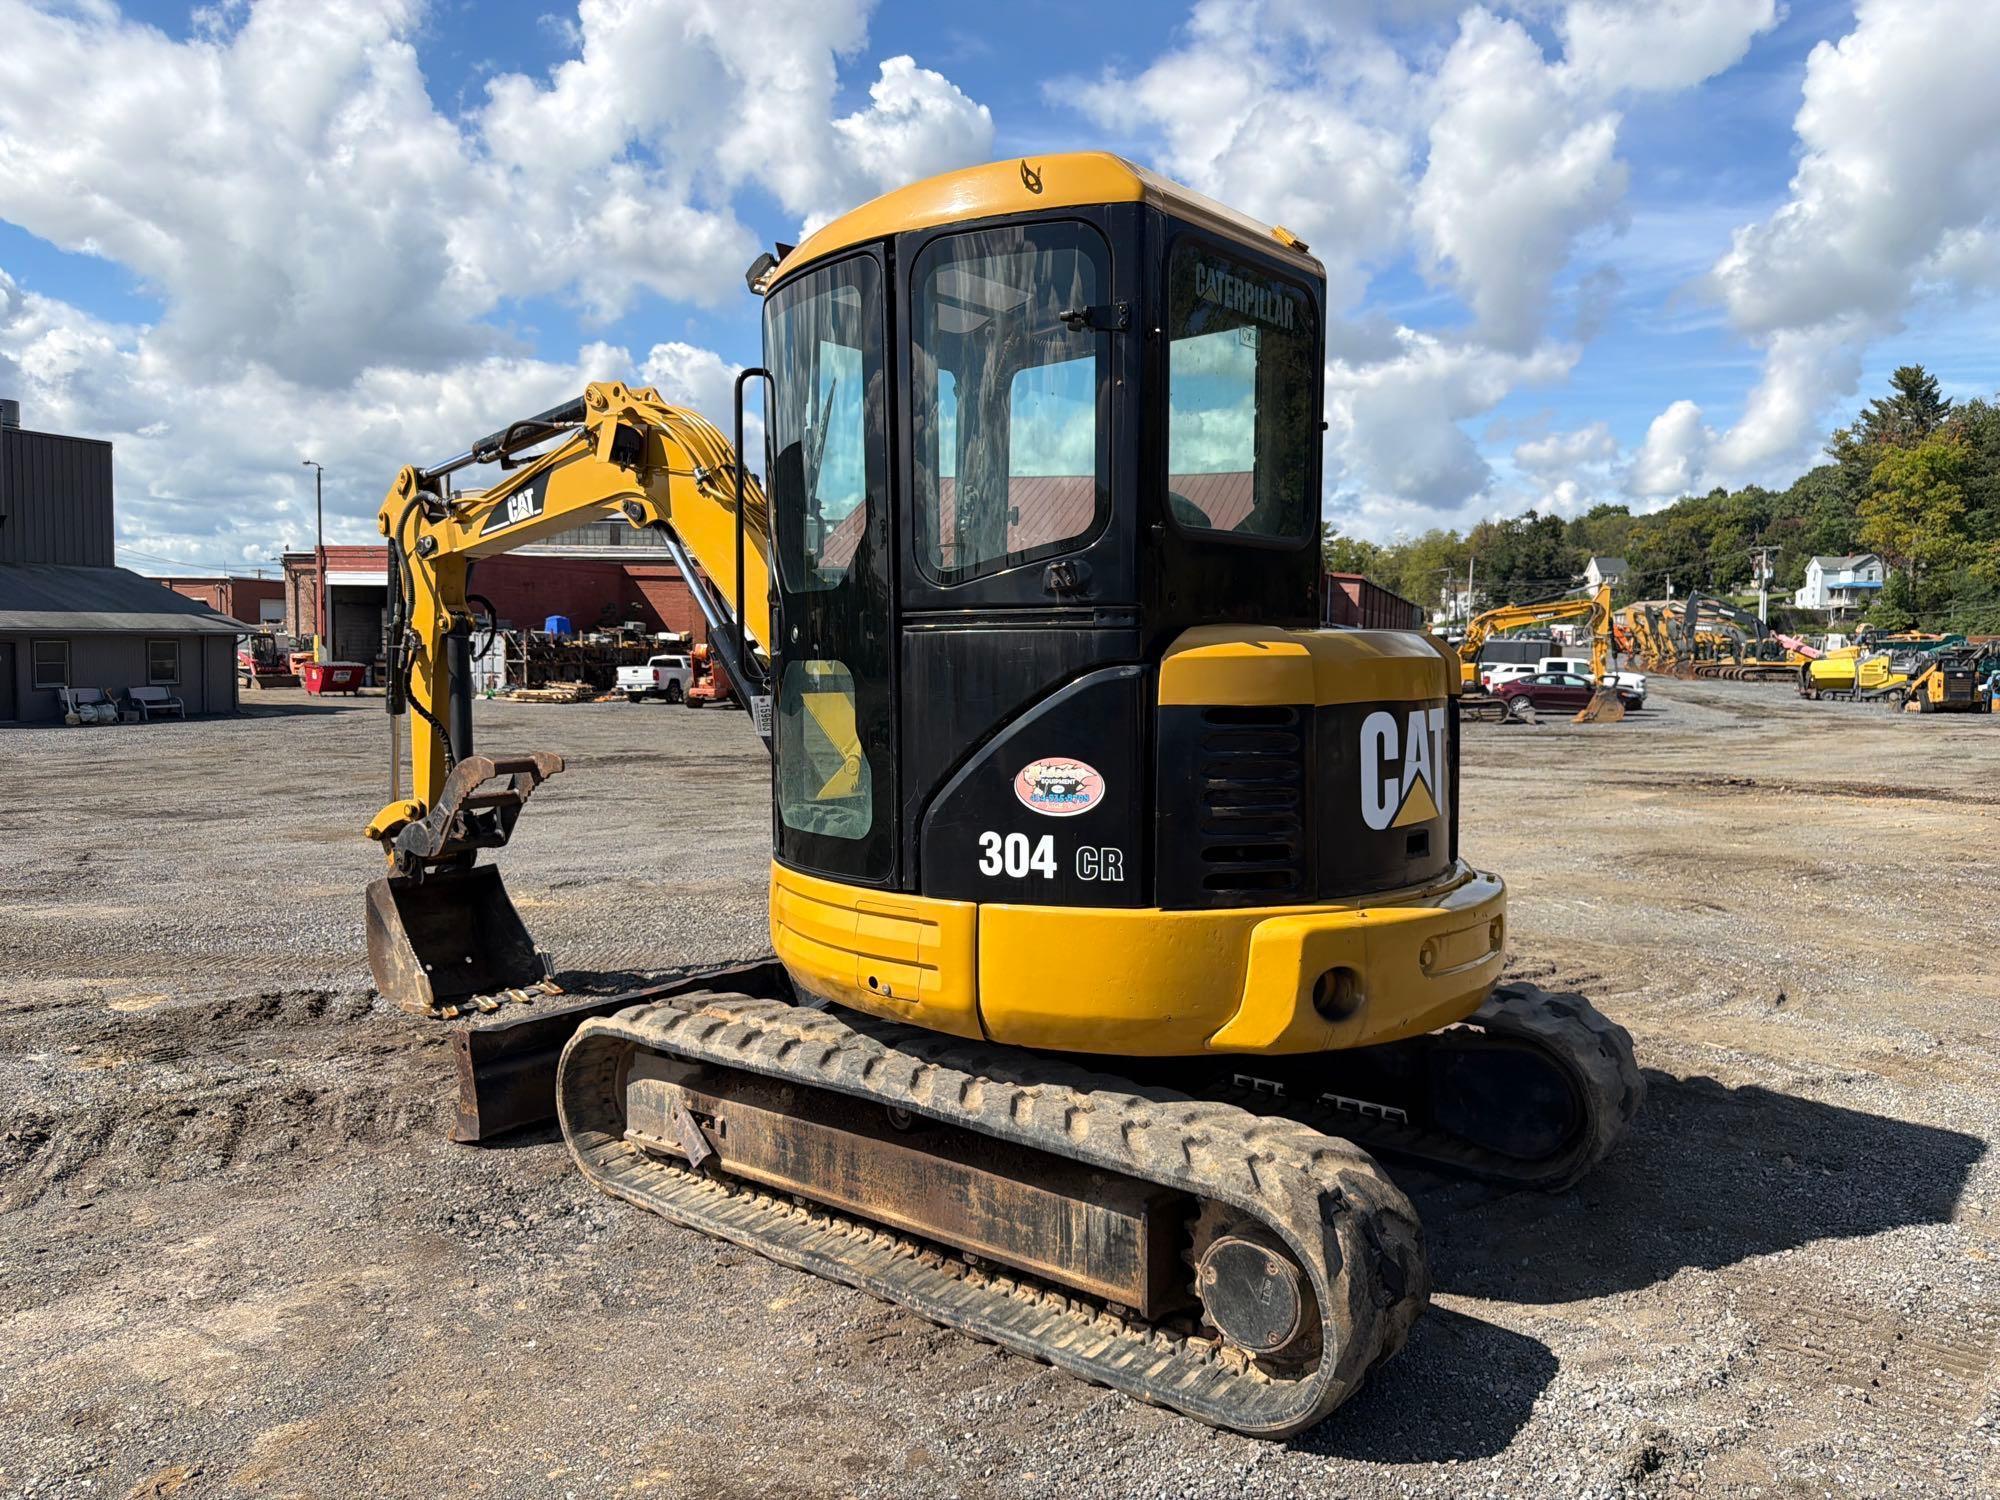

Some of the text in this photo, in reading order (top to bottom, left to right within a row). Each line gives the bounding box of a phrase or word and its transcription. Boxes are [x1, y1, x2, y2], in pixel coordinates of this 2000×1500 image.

[1195, 262, 1294, 330] CATERPILLAR
[507, 488, 534, 523] CAT
[1360, 707, 1445, 830] CAT
[978, 831, 1124, 882] 304 CR
